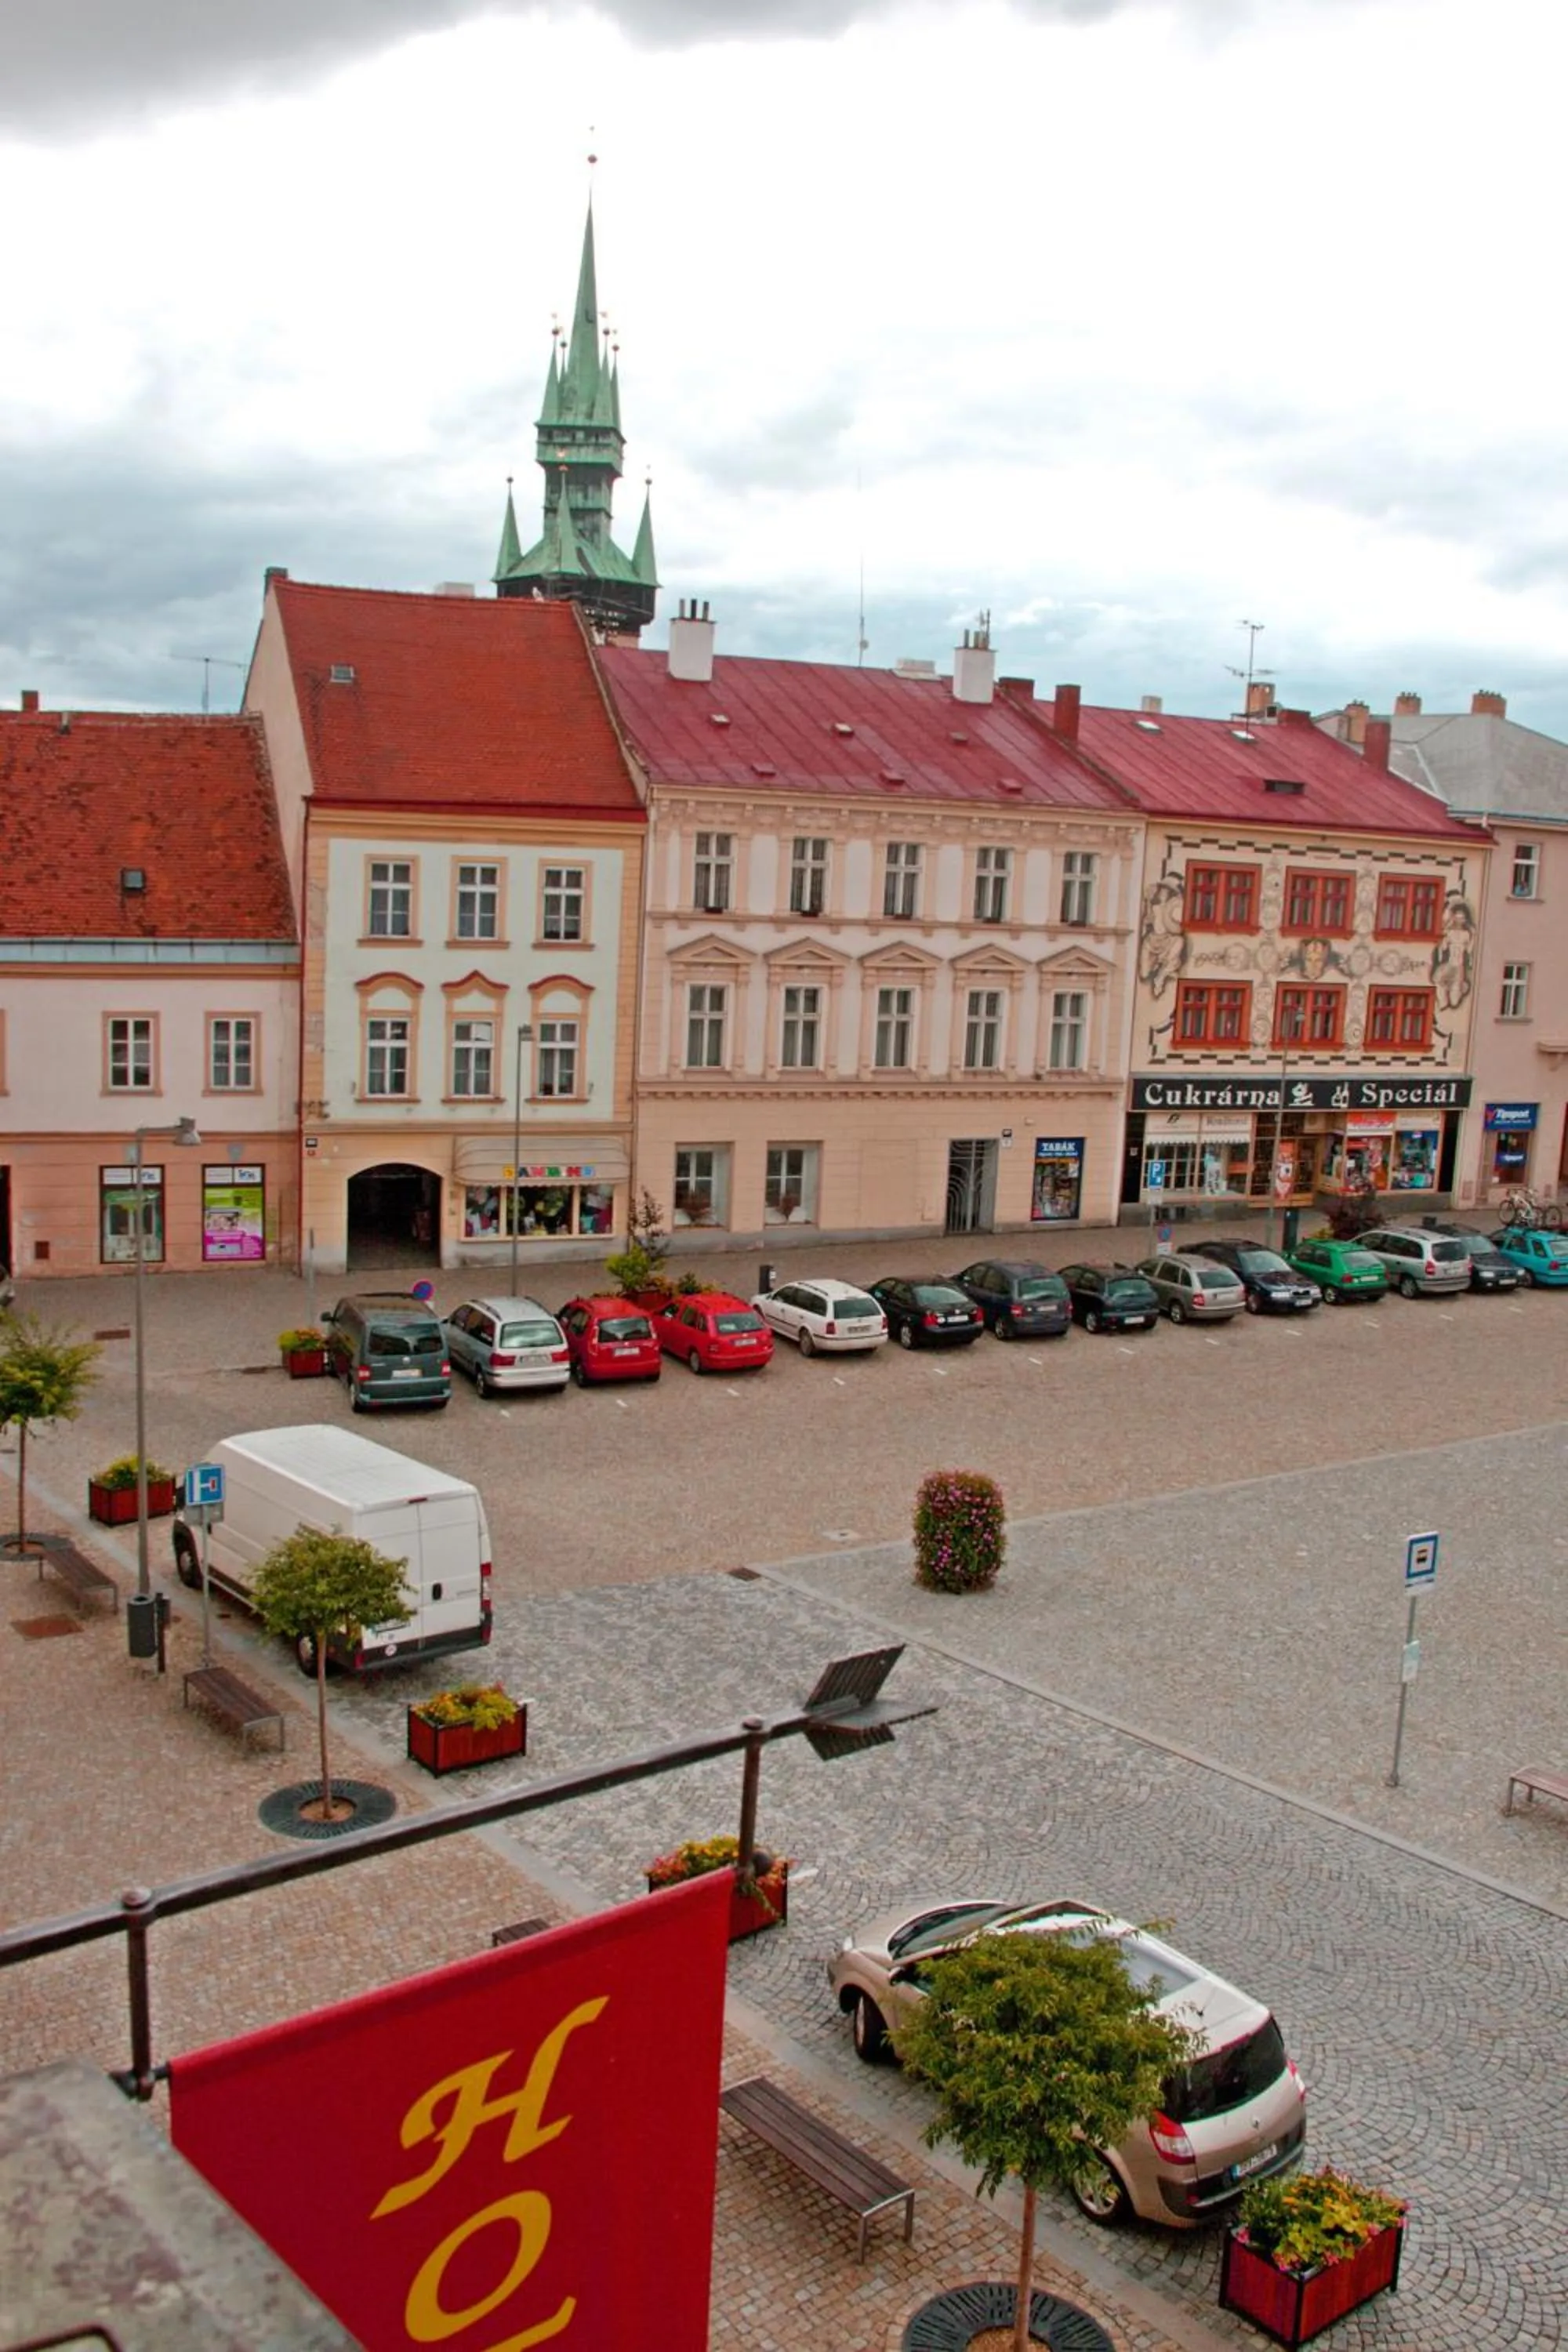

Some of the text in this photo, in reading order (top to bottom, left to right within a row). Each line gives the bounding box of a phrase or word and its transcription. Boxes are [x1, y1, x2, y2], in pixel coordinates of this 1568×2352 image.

[1145, 1083, 1280, 1109] Cukrárna
[1360, 1083, 1456, 1108] Speciál
[1042, 1141, 1076, 1152] TABÁK
[370, 1995, 611, 2352] HO
